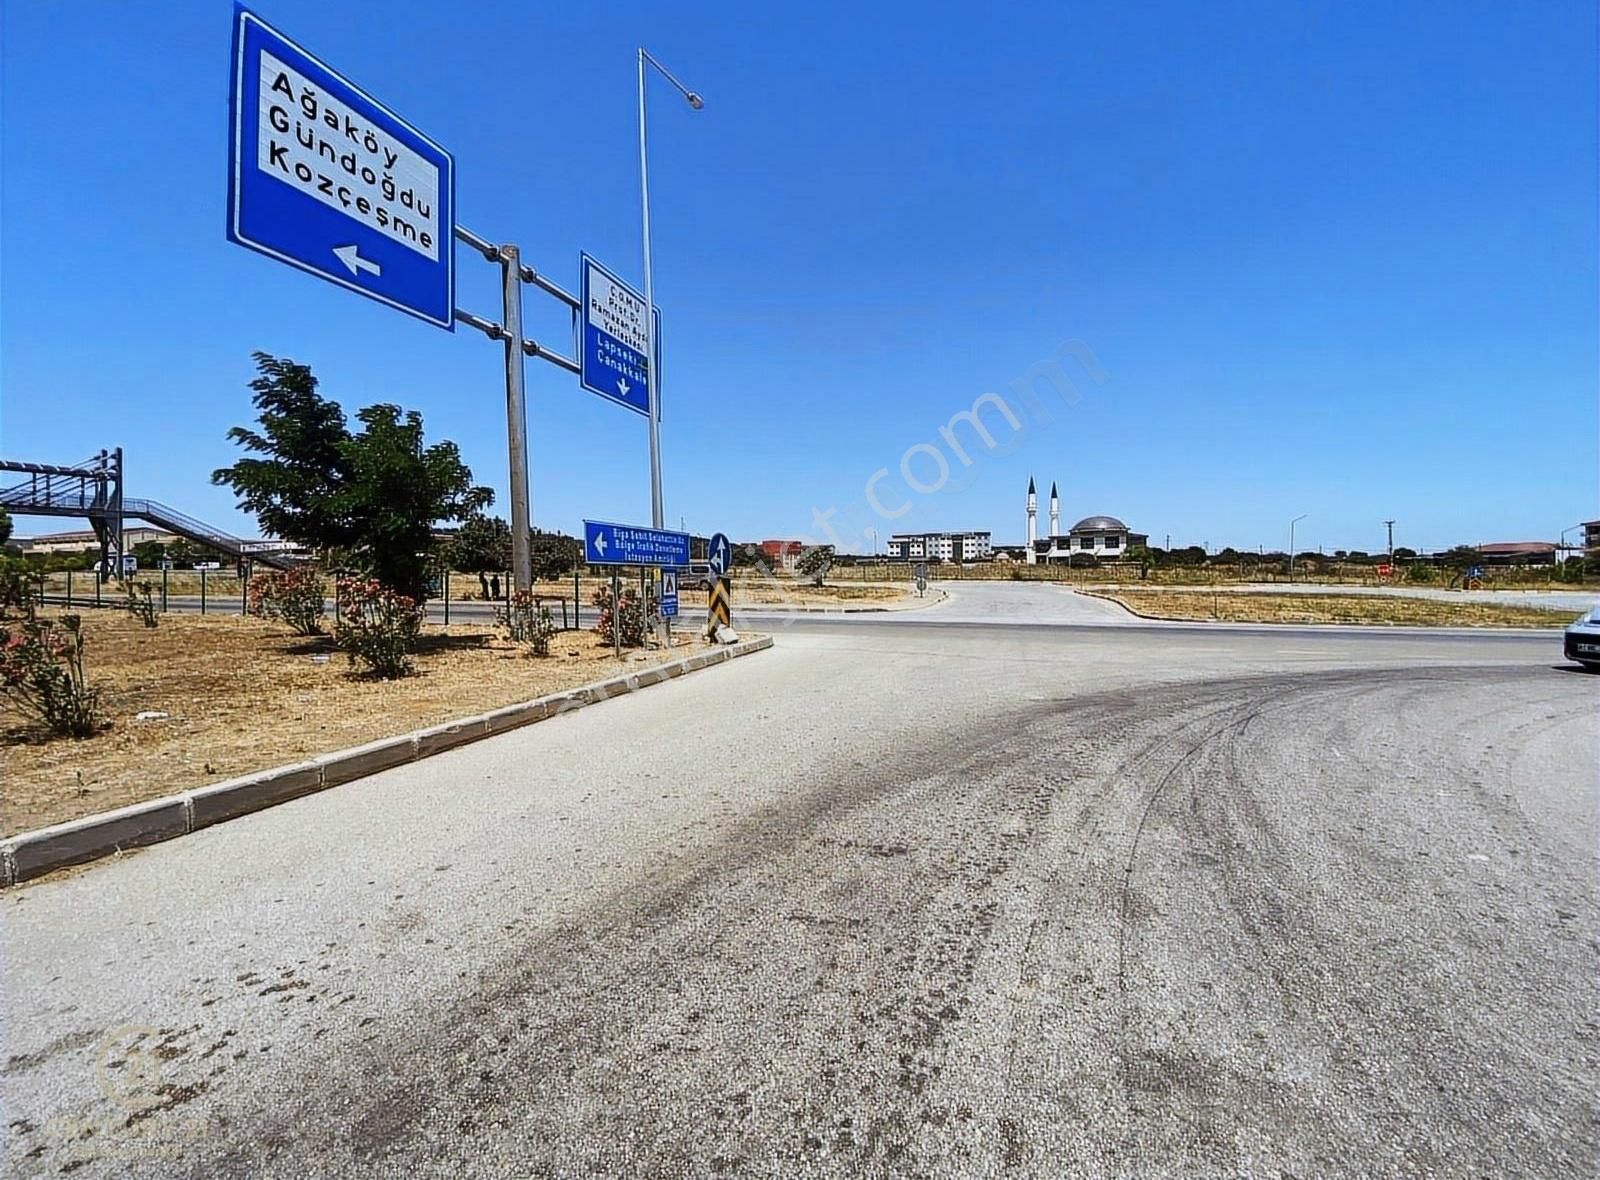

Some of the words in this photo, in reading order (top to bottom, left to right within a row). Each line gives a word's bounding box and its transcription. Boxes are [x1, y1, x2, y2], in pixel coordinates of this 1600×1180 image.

[269, 105, 431, 219] Gündoğdu
[272, 72, 398, 169] Ağaköy
[269, 140, 432, 248] Kozçeşme
[597, 332, 637, 366] Lapseki
[597, 349, 647, 386] Çanakkale
